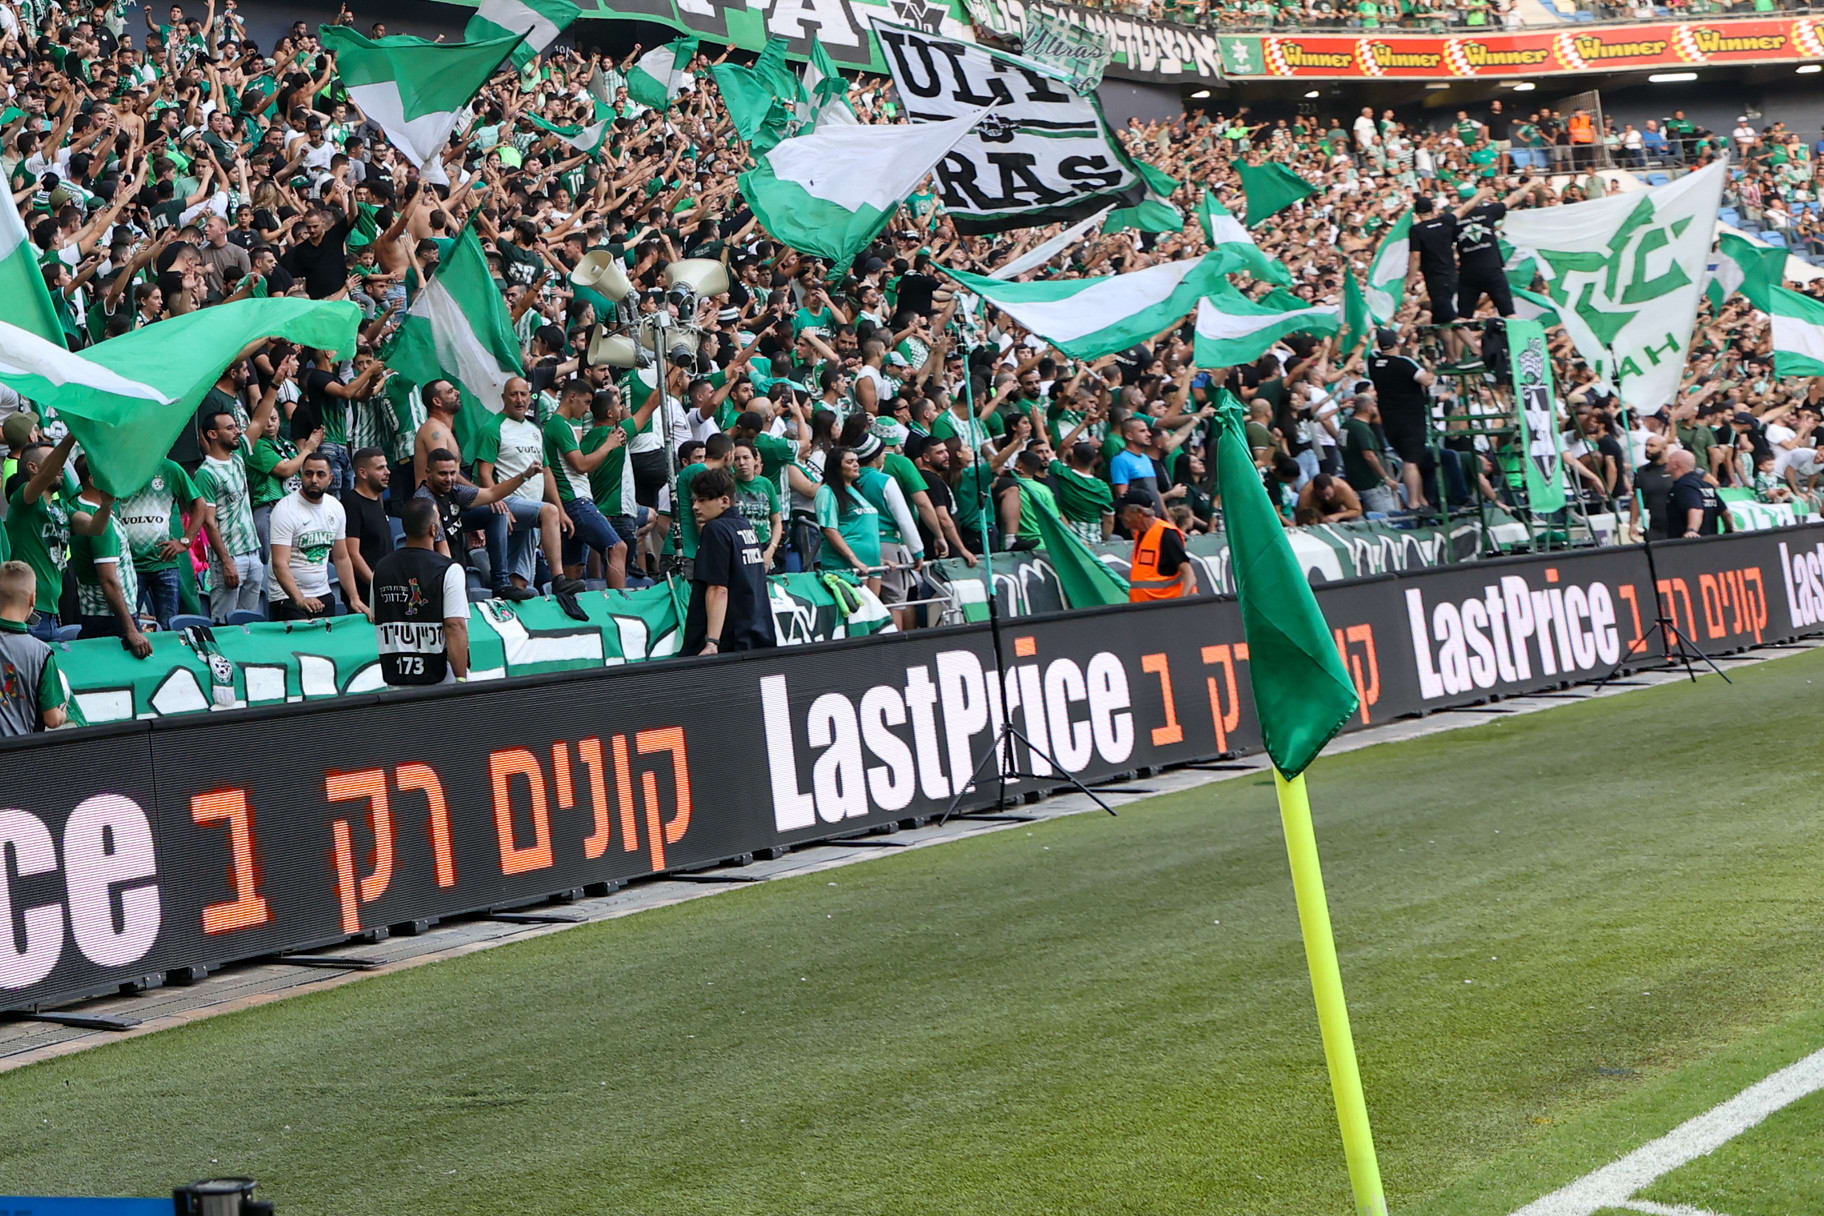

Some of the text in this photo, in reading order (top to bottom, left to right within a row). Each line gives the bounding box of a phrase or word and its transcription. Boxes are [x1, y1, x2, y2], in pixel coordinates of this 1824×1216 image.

[938, 152, 1122, 210] RAS
[121, 515, 164, 525] VOLVO
[1405, 567, 1620, 700] LastPrice
[1619, 584, 1648, 653] ב
[1699, 567, 1769, 644] קונים
[396, 656, 425, 675] 173
[1141, 652, 1185, 747] ב
[760, 636, 1134, 833] LastPrice
[191, 726, 692, 933] קונים רק ב
